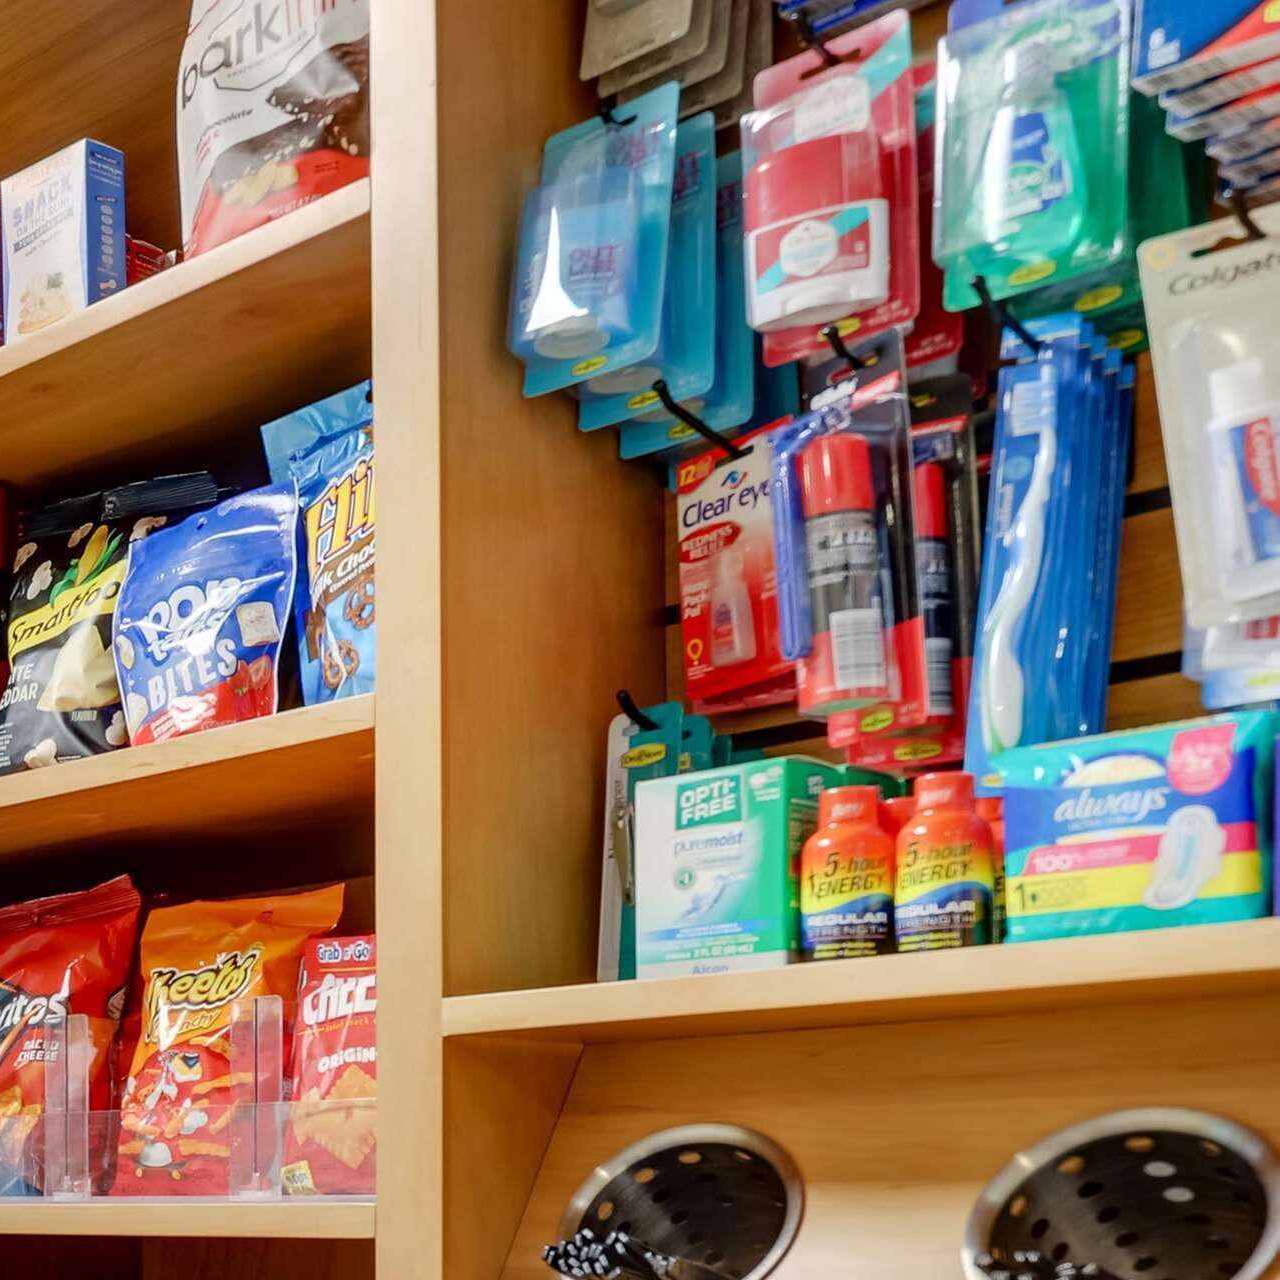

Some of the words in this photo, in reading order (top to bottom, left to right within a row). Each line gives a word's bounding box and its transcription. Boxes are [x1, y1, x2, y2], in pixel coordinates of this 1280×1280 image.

[12, 175, 73, 228] SNACK
[683, 492, 735, 528] Clear
[148, 639, 238, 711] BITES
[679, 777, 738, 809] OPTI-
[1053, 784, 1173, 824] always
[680, 794, 738, 826] FREE
[825, 850, 887, 878] 5-hour
[906, 841, 974, 868] 5-hour
[815, 871, 887, 902] ENERGY
[899, 860, 975, 888] ENERGY
[317, 943, 341, 964] Grab
[353, 941, 370, 960] Go
[691, 962, 730, 977] Alcon
[15, 1050, 60, 1066] CHEESE
